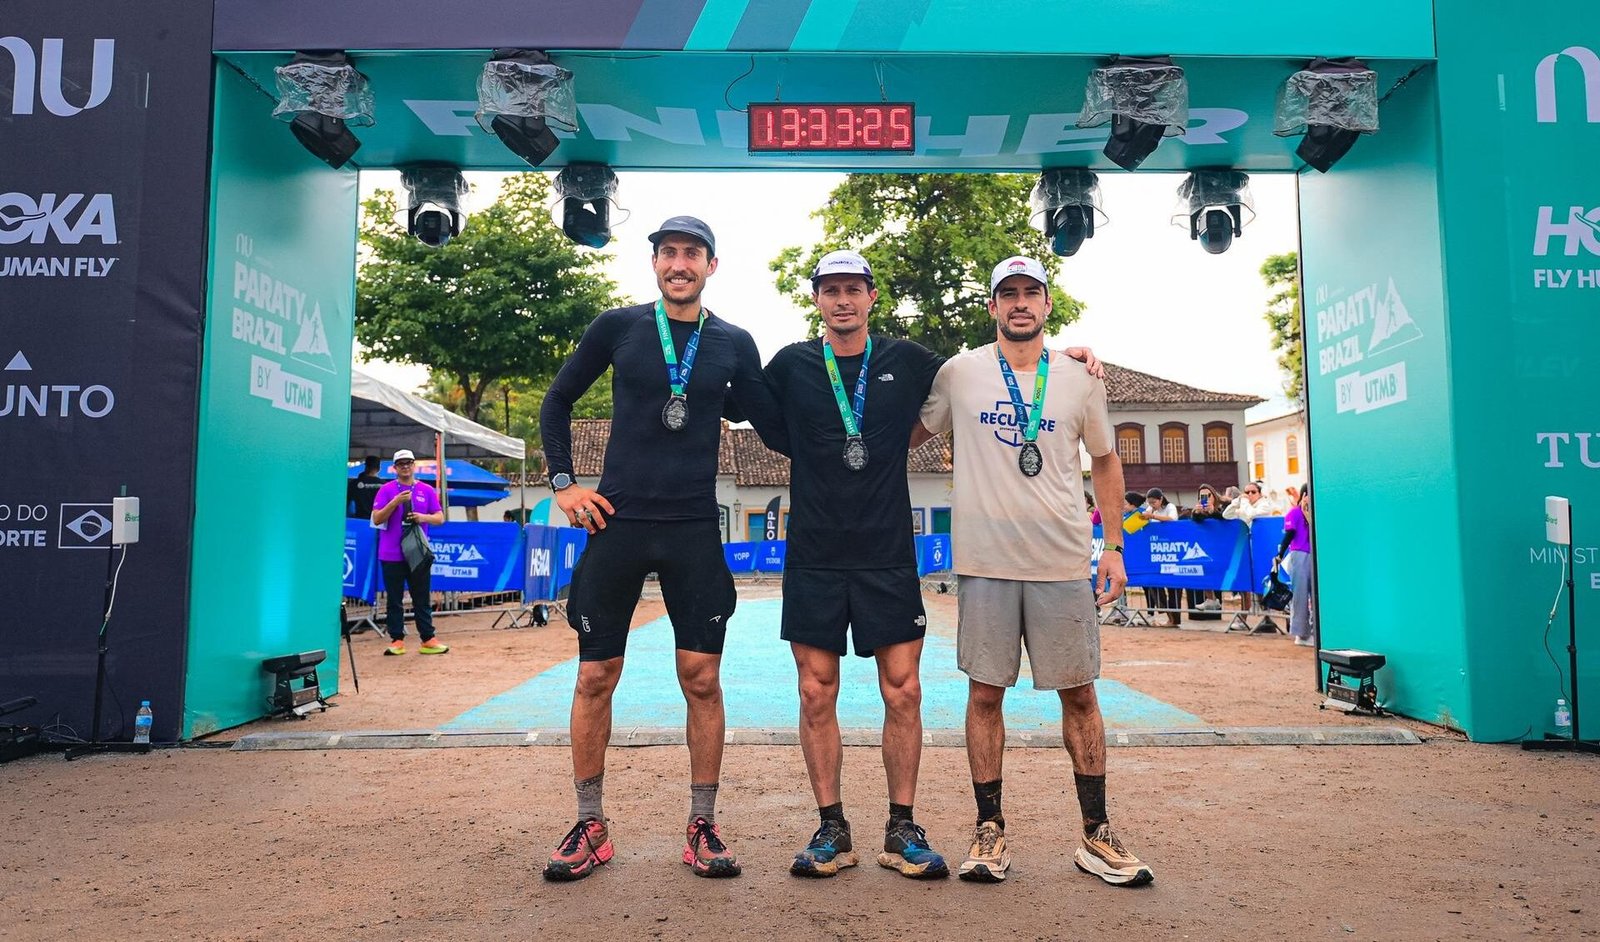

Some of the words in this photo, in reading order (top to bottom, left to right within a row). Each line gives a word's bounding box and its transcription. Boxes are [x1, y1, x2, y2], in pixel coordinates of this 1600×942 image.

[402, 99, 1249, 158] FNIHER
[766, 108, 910, 147] 13:33:25
[74, 257, 116, 277] FLY
[1534, 269, 1572, 288] FLY
[1577, 269, 1600, 288] H
[233, 261, 307, 326] PARATY
[1317, 283, 1378, 344] PARATY
[232, 307, 287, 356] BRAZIL
[1319, 334, 1364, 377] BRAZIL
[257, 366, 272, 391] BY
[284, 380, 314, 410] UTMB
[1341, 382, 1353, 405] BY
[1365, 373, 1398, 404] UTMB
[17, 504, 48, 521] DO
[766, 511, 776, 540] OPP
[733, 552, 750, 561] YOPP
[1150, 542, 1189, 553] PARATY
[1151, 554, 1180, 563] BRAZIL
[1530, 547, 1599, 564] MINST
[452, 568, 473, 576] UTMB
